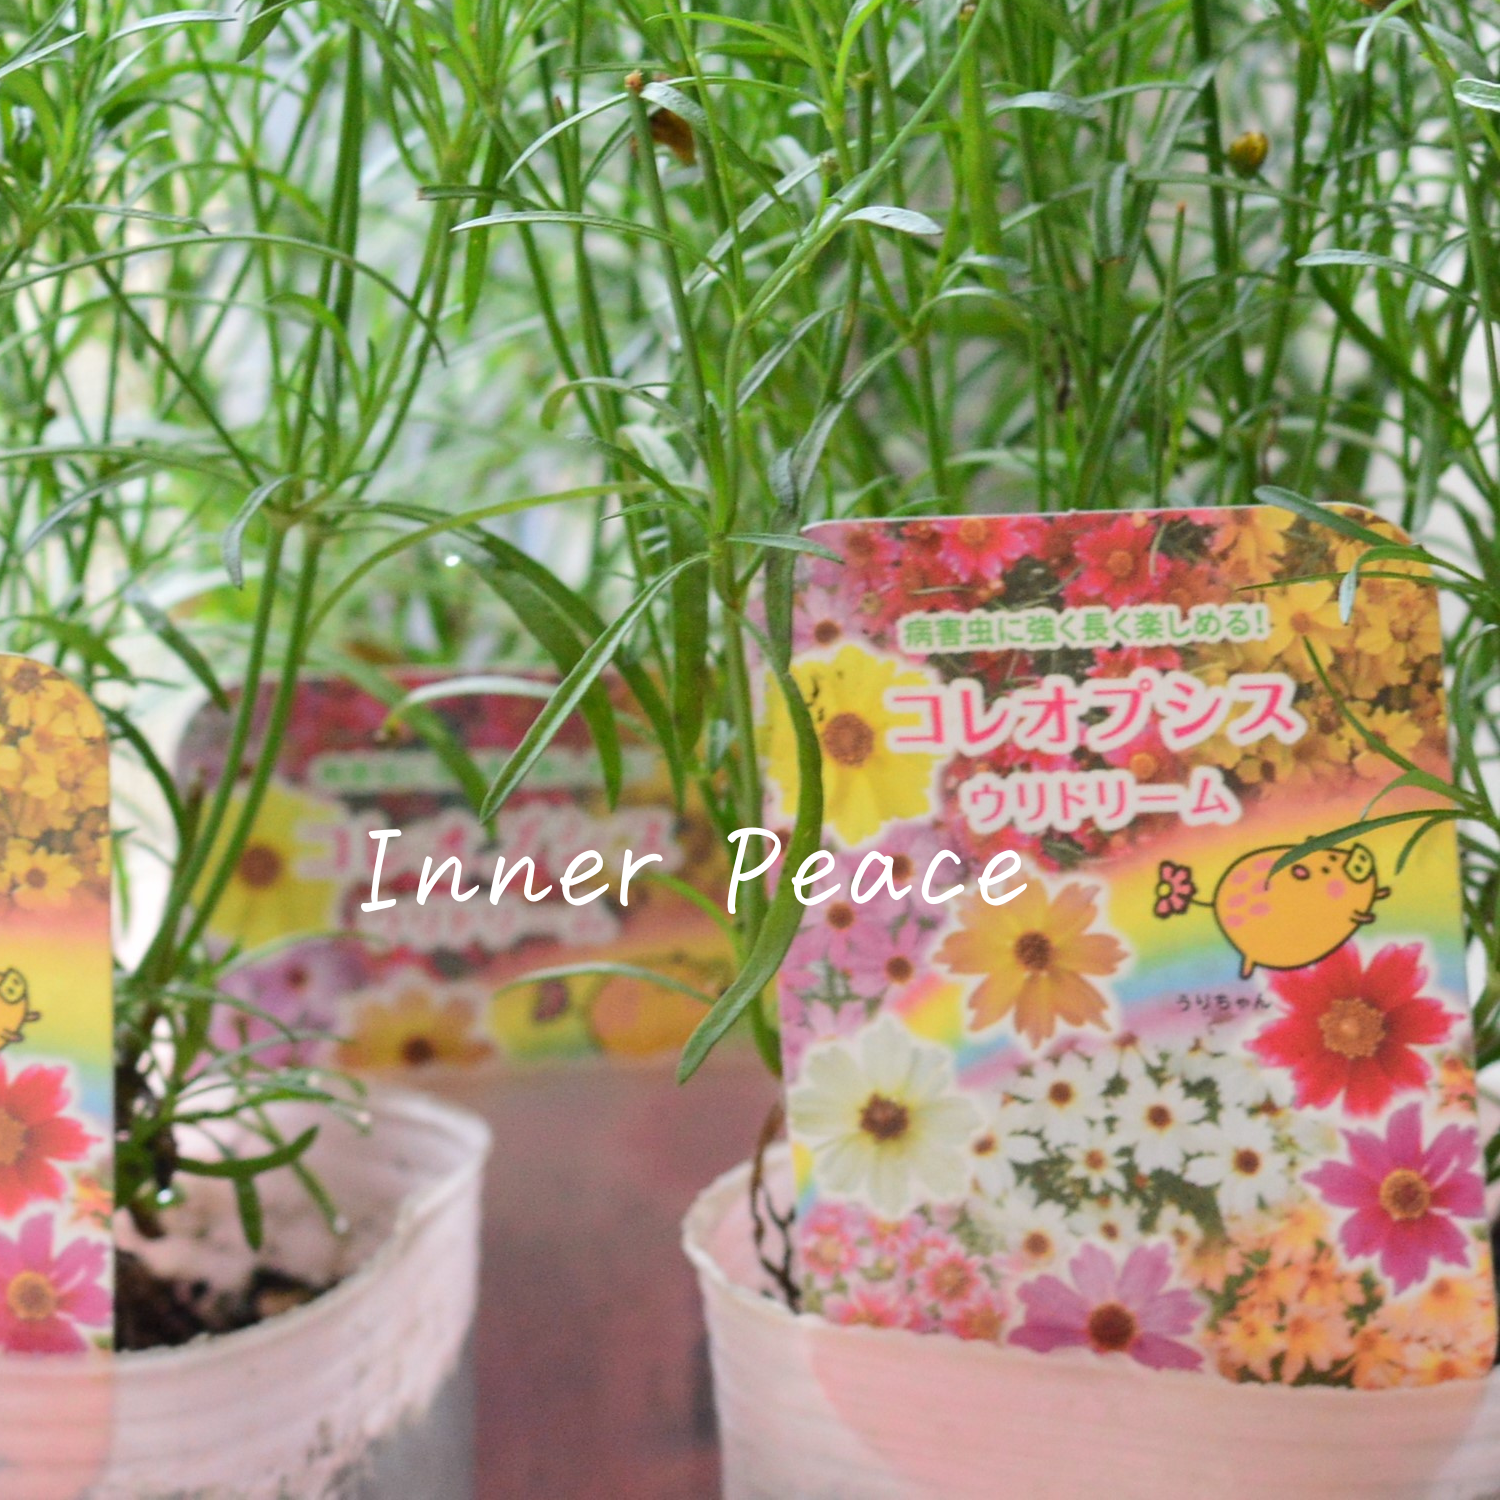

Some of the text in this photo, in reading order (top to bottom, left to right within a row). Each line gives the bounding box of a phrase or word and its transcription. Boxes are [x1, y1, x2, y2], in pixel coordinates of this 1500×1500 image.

[904, 610, 1266, 647] 病害虫に強く長く楽しめる!
[893, 678, 1296, 745] コレオプシス
[969, 777, 1231, 823] ウリドリーム
